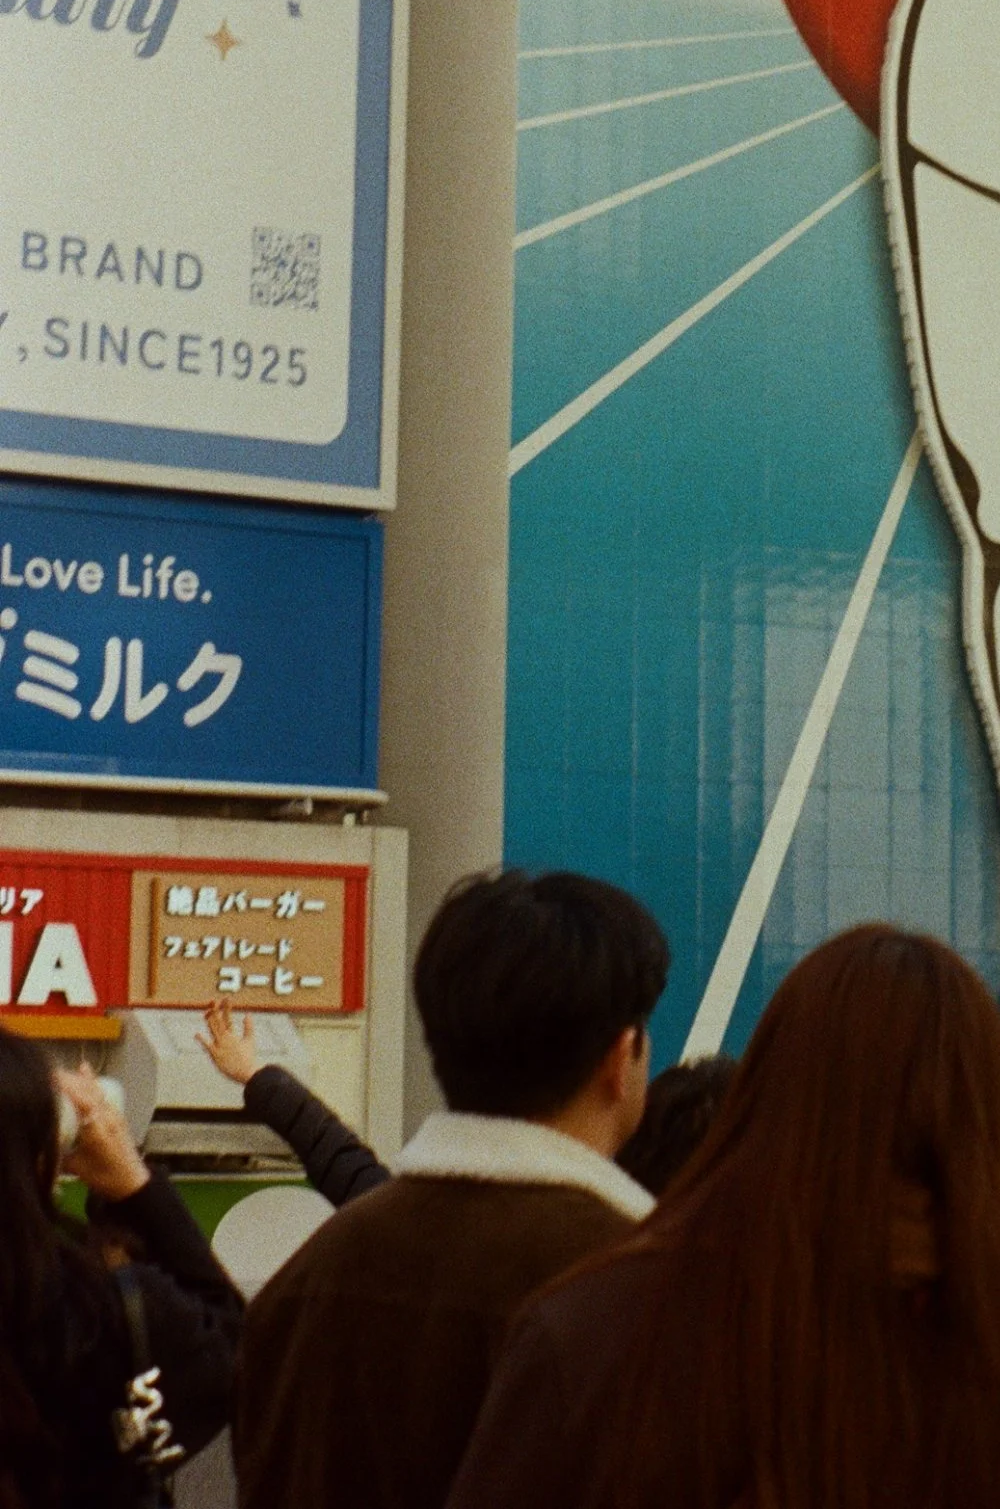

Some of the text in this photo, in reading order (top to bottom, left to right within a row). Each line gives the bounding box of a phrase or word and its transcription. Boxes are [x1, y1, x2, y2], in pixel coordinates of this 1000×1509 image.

[21, 230, 204, 292] BRAND
[0, 542, 213, 604] Love Life.
[0, 607, 243, 728] ミルク
[166, 884, 328, 920] 絶品バーガー
[163, 935, 294, 962] フェアトレード
[217, 966, 325, 996] コーヒー
